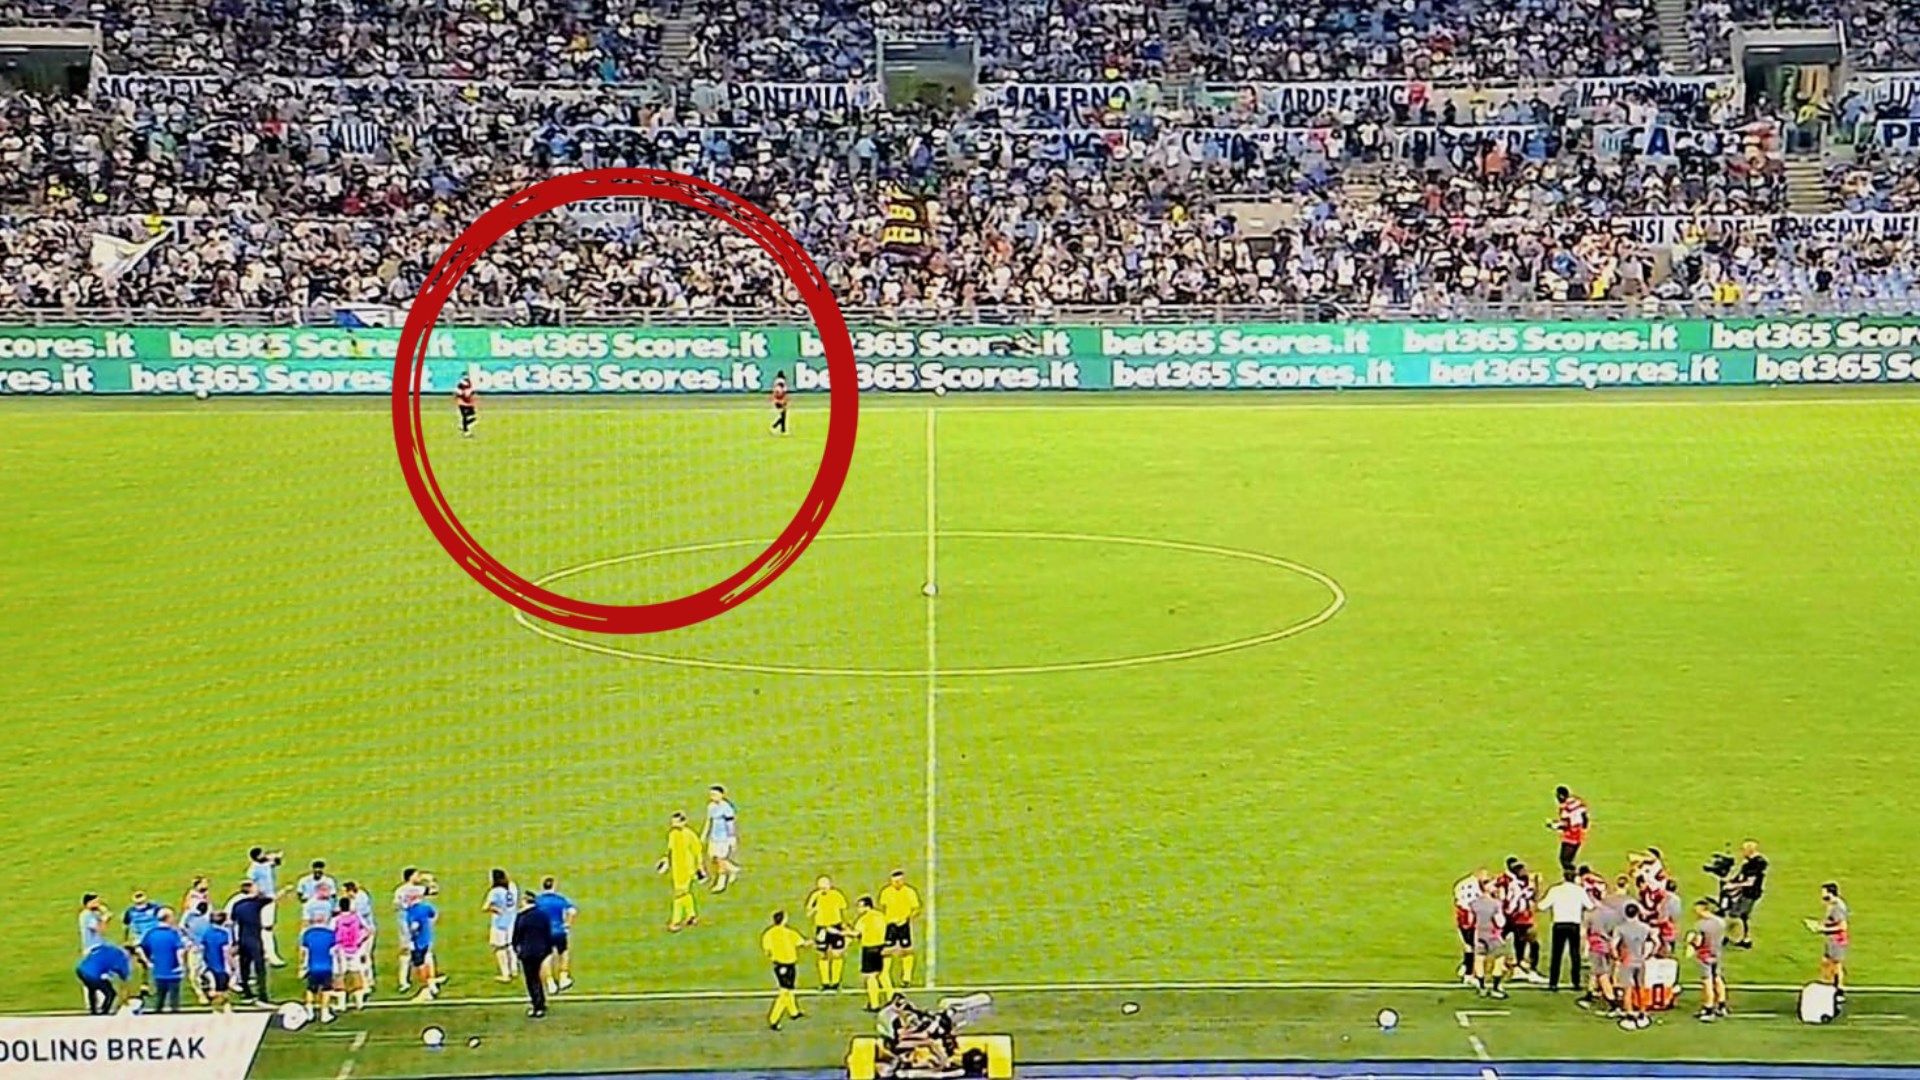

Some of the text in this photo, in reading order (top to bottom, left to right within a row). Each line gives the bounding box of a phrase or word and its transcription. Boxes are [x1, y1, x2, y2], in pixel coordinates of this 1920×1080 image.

[728, 82, 849, 110] PONTINIA
[170, 331, 457, 358] bet365 Scoreit
[490, 330, 768, 358] bet365 Scores.it
[800, 331, 915, 357] b365
[1102, 327, 1370, 356] bet365 Scores.it
[1402, 323, 1678, 354] bet365 Scores.it
[1712, 321, 1920, 349] bet365 Scor
[130, 364, 260, 391] bet365
[469, 361, 762, 390] bet365 Scores.it
[920, 361, 1079, 388] Scores.it
[1113, 358, 1394, 387] bet365 Scores.it
[1429, 353, 1721, 384] bet365 Scores.it
[1756, 353, 1882, 380] bet365
